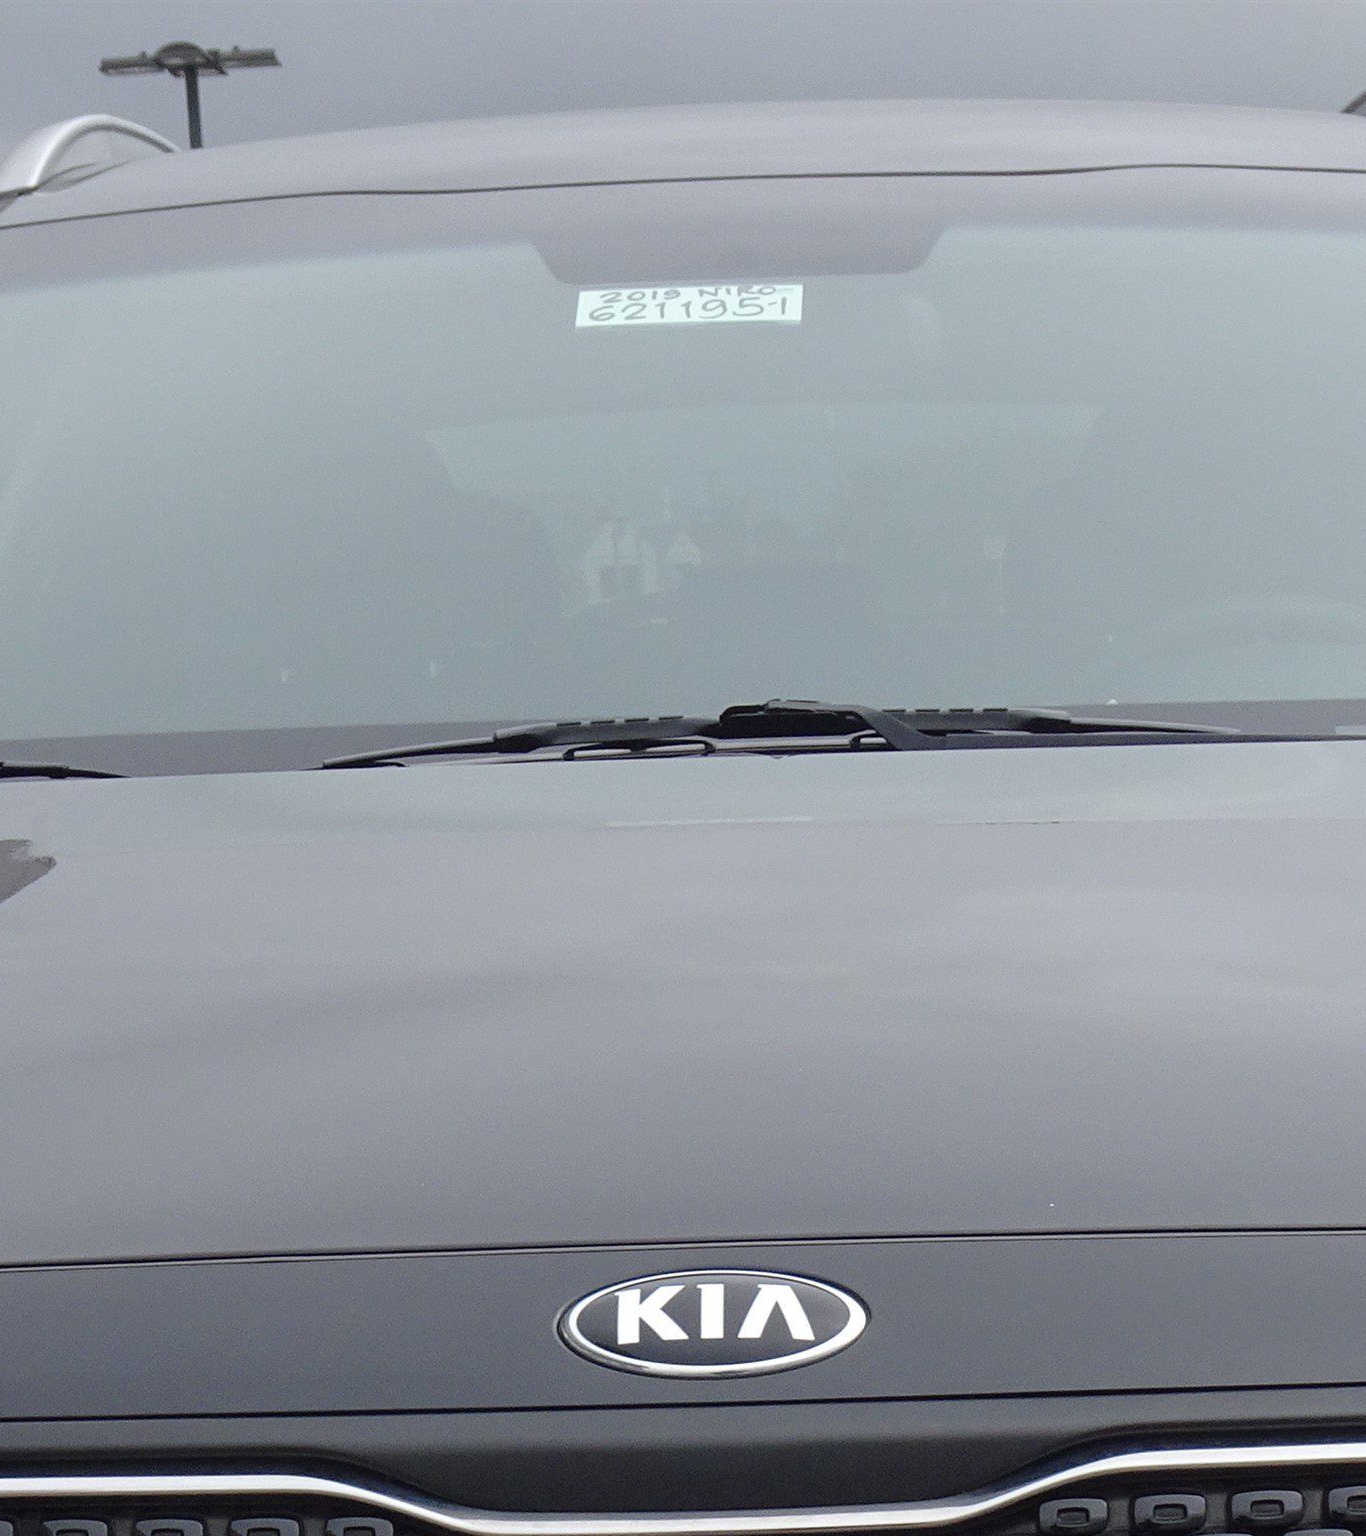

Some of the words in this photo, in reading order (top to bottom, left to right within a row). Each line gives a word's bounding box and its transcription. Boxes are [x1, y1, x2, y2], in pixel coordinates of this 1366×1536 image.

[588, 296, 788, 321] 621195-1
[599, 289, 681, 304] 2019
[614, 1282, 816, 1346] KIA
